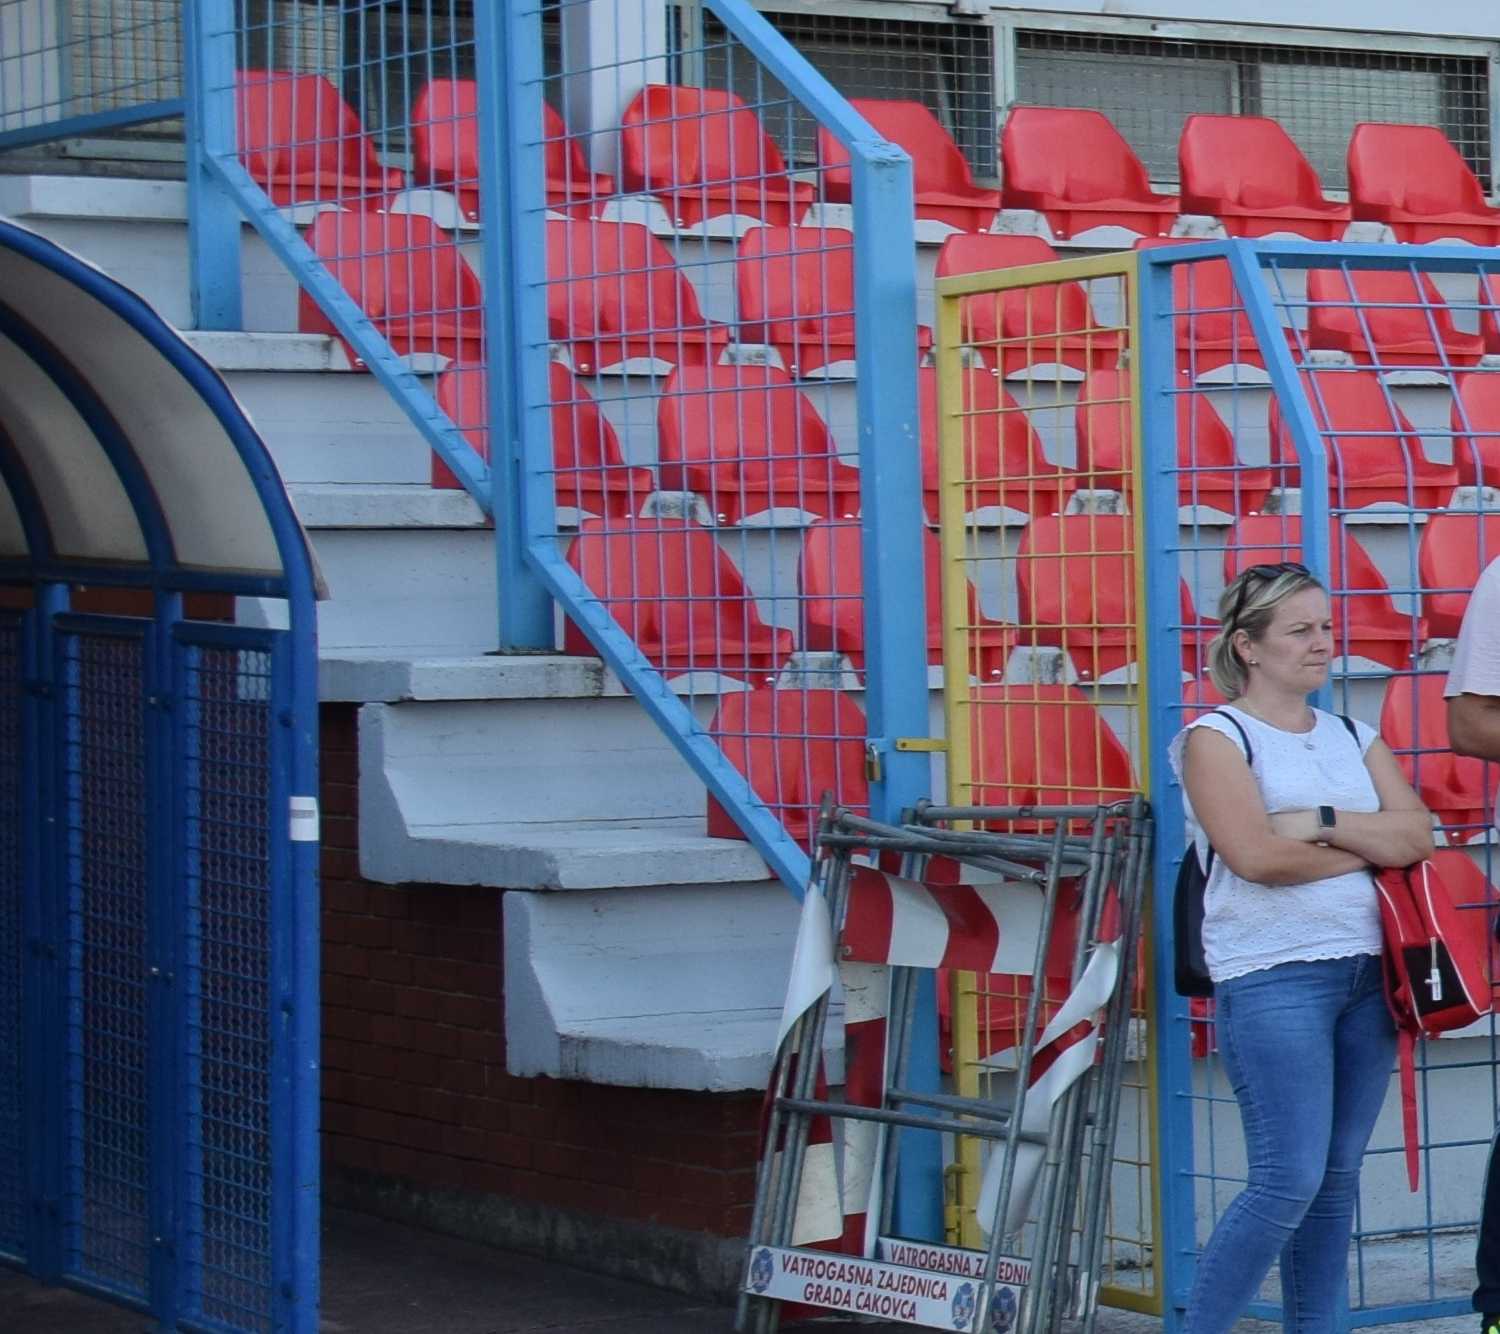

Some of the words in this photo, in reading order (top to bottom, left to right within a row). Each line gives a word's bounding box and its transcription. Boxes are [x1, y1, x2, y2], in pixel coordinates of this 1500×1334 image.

[781, 1253, 874, 1287] VATROGASNA
[876, 1270, 948, 1301] ZAJEDNICA
[890, 1243, 972, 1276] VATROGASNA
[975, 1257, 1032, 1284] ZEDNI
[803, 1282, 852, 1308] GRADA
[855, 1286, 917, 1321] ČAKOVCA
